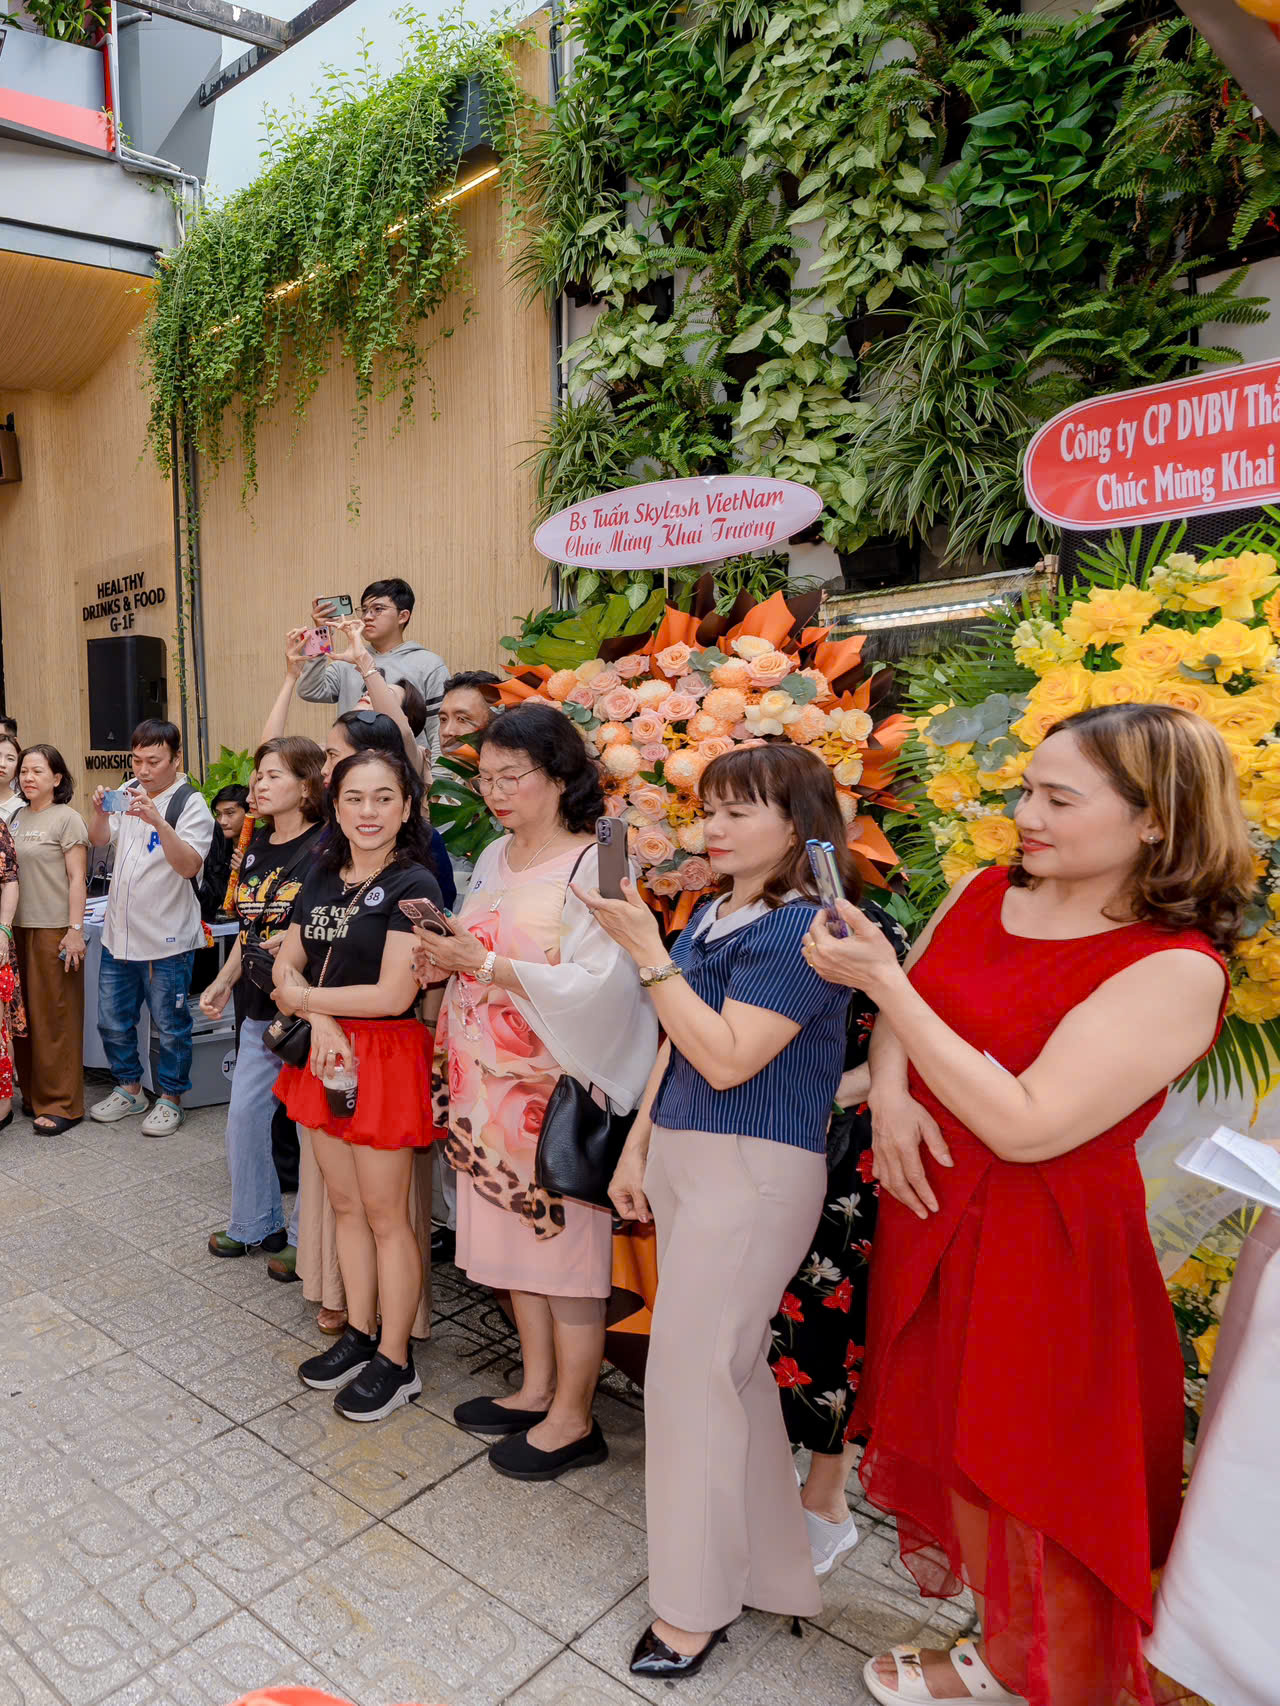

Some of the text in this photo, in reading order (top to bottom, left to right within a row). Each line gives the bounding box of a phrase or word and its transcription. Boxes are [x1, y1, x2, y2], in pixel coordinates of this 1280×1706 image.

[1060, 422, 1112, 464] Công
[1117, 418, 1138, 459] ty
[1143, 403, 1171, 446] CP
[1177, 388, 1239, 440] DVBV
[1096, 444, 1275, 512] Chúc Mừng Khai
[569, 488, 784, 532] Bs Tuấn Skylash VietNam
[565, 517, 776, 558] Chúc Mừng Khai Trương
[96, 571, 145, 600] HEALTHY
[82, 587, 166, 622] DRINKS & FOOD
[110, 612, 135, 633] G-1F
[84, 753, 133, 770] WORKSHO
[310, 905, 329, 915] BE
[368, 891, 380, 901] 38
[311, 914, 330, 927] TO
